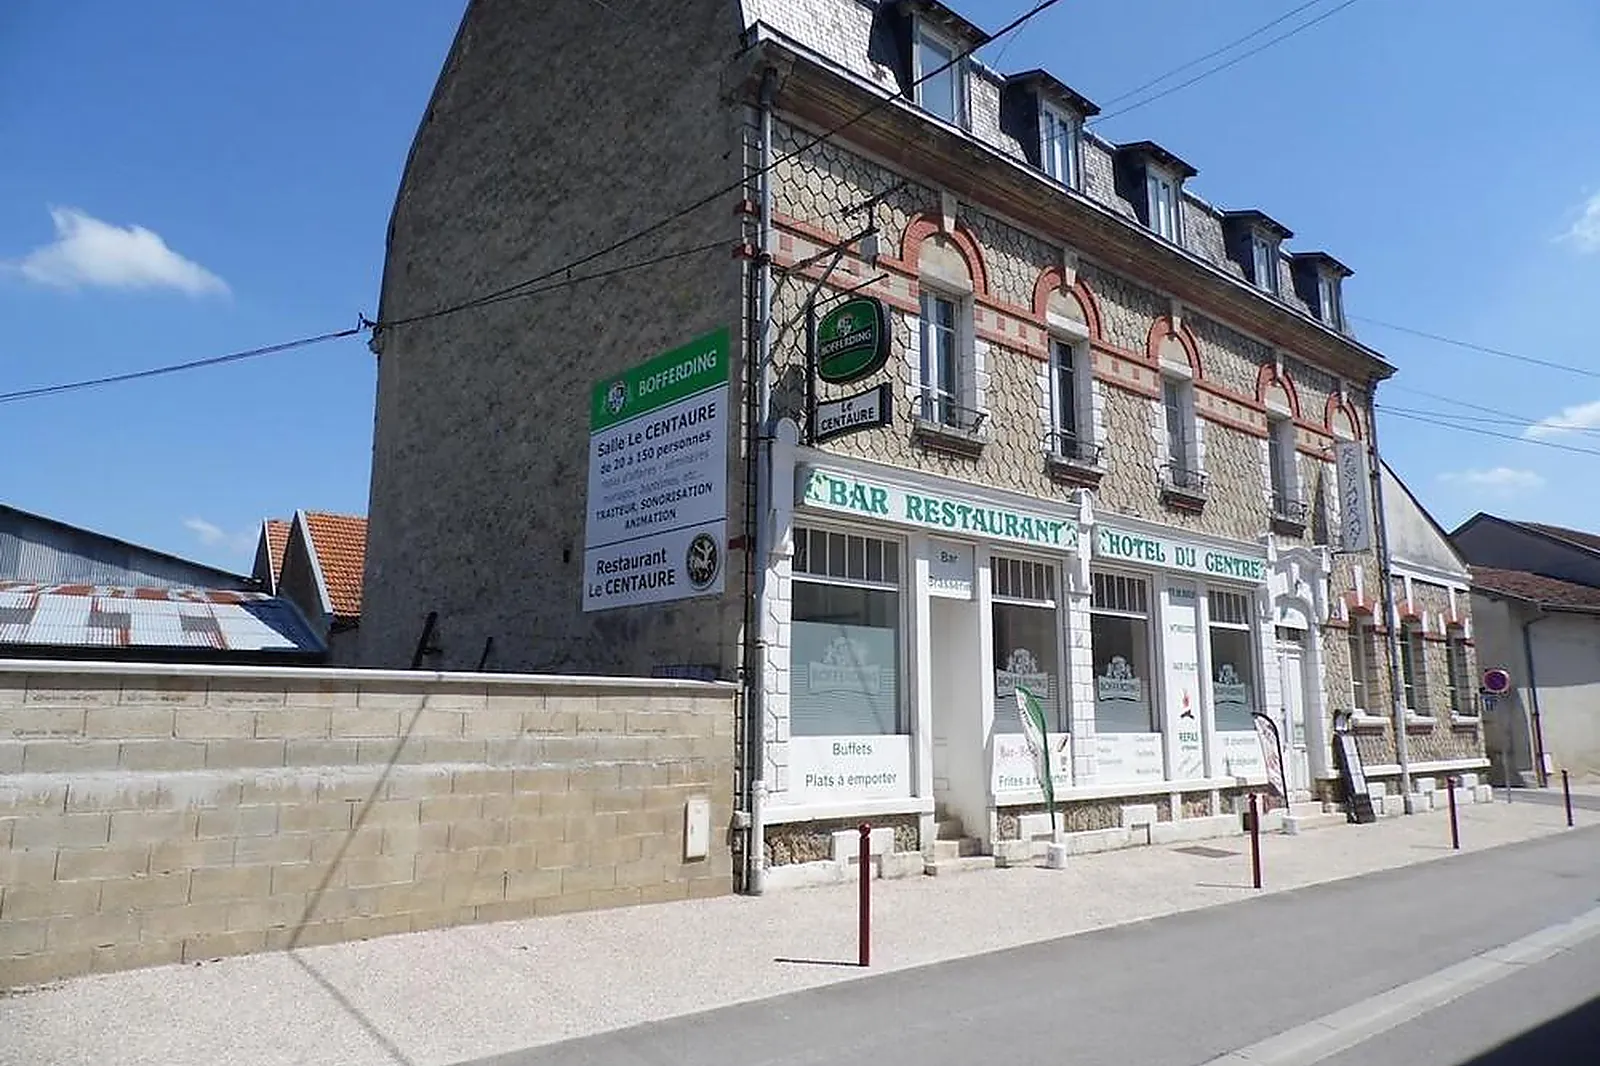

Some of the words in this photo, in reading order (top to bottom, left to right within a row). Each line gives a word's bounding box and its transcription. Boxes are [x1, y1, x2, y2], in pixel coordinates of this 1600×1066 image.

[639, 350, 717, 396] BOFFERDING
[821, 407, 875, 430] CENTAURE
[841, 402, 853, 413] Le
[598, 437, 625, 457] Salle
[627, 432, 642, 446] Le
[645, 402, 716, 440] CENTAURE
[601, 461, 612, 474] de
[614, 457, 626, 470] 20
[637, 447, 655, 462] 150
[656, 430, 711, 459] personnes
[641, 482, 713, 510] SONORISATION
[625, 508, 677, 529] ANIMATION
[829, 478, 889, 515] BAR
[905, 494, 1064, 545] RESTAURANT
[596, 547, 667, 575] Restaurant
[940, 551, 957, 563] Bar
[1108, 531, 1166, 563] HOTEL
[1175, 547, 1197, 567] DU
[1205, 552, 1260, 579] CENTRE
[588, 583, 601, 598] Le
[605, 569, 676, 594] CENTAURE
[832, 742, 873, 756] Buffets
[805, 774, 834, 787] Plats
[847, 773, 897, 787] emporter
